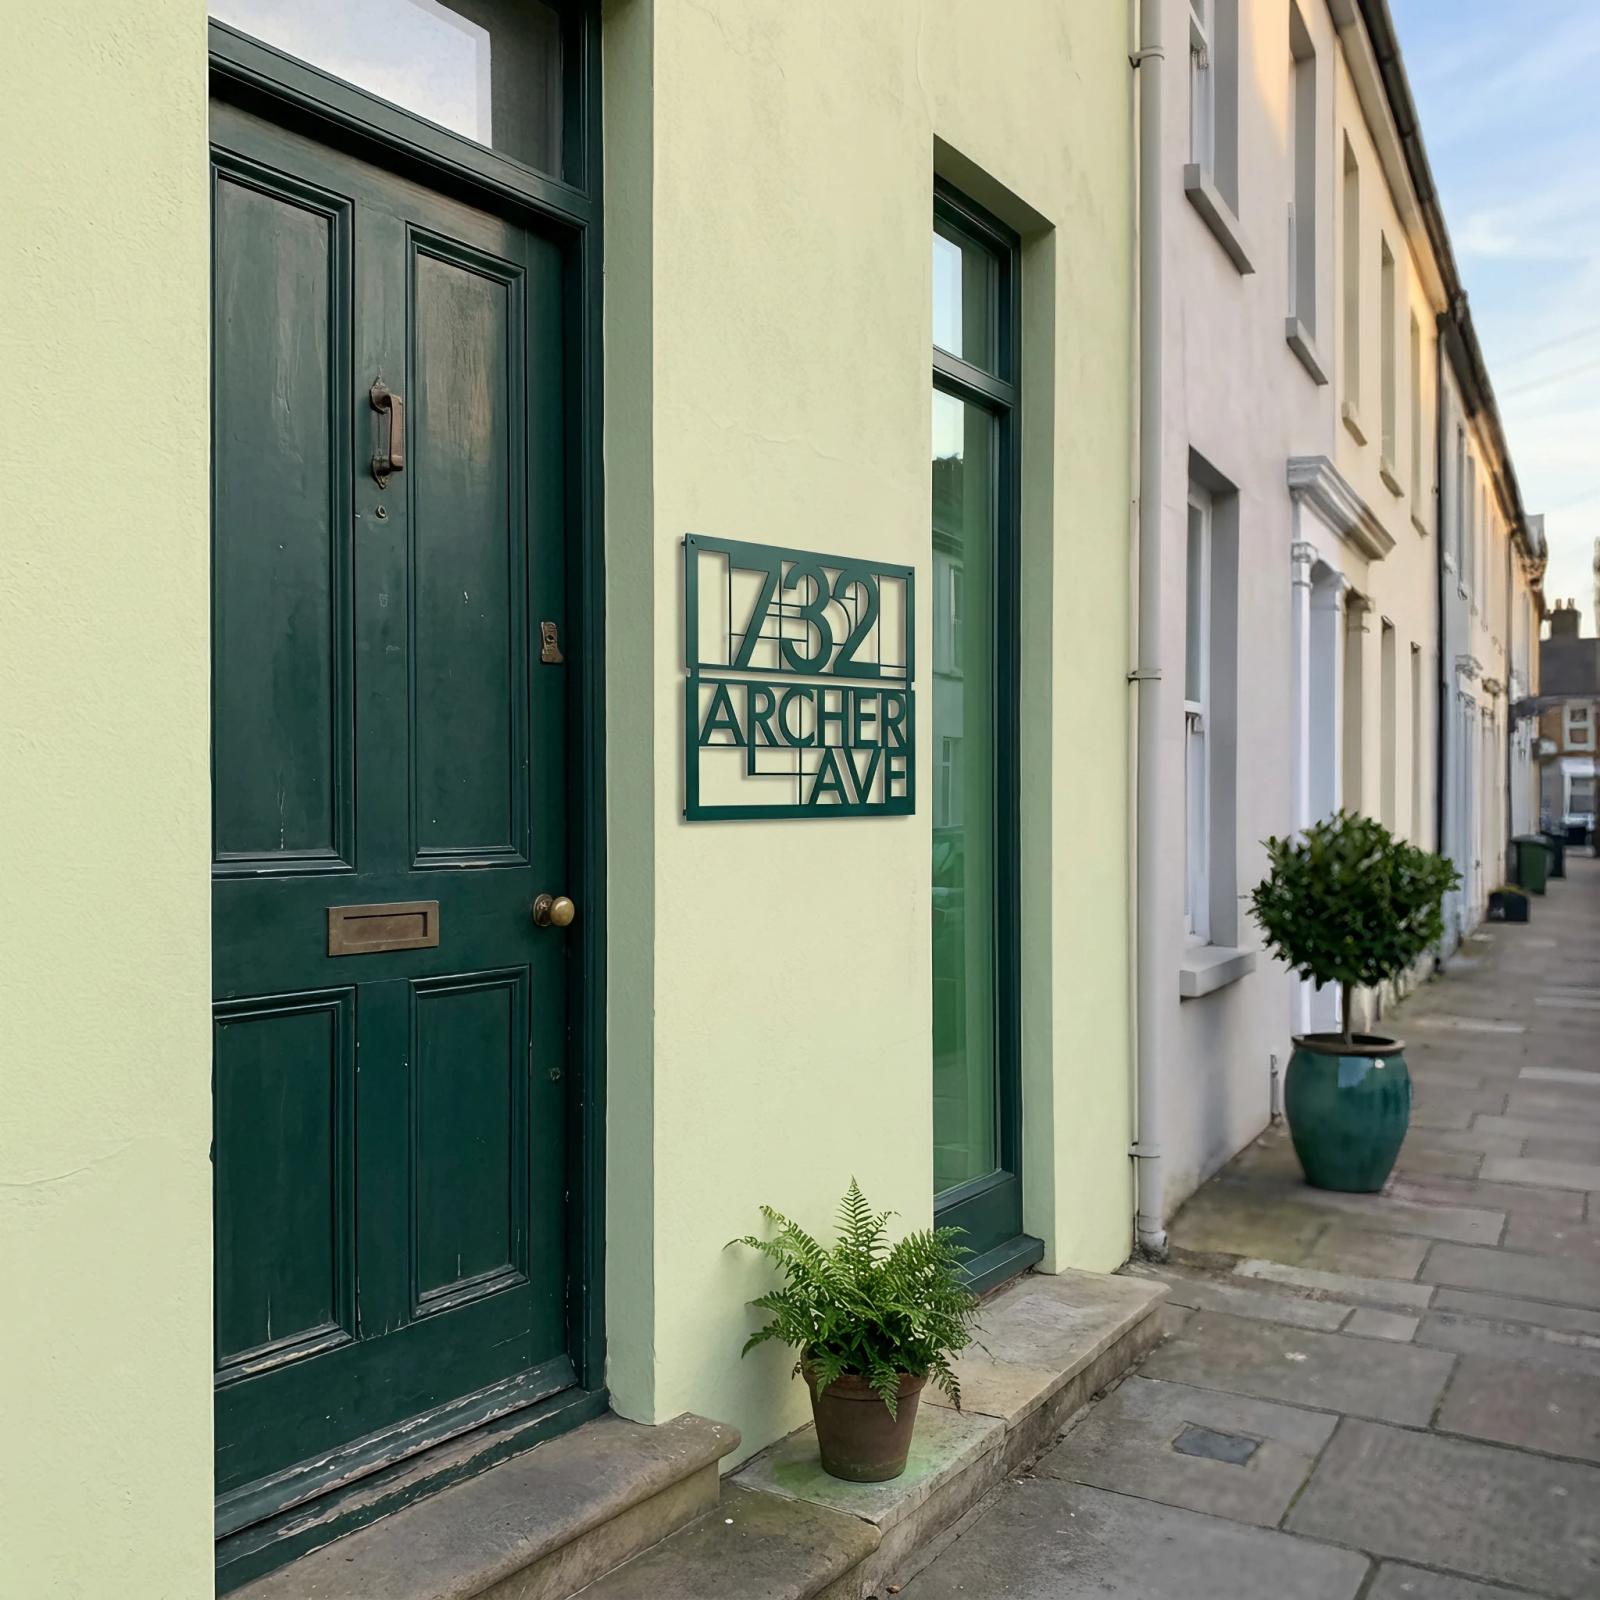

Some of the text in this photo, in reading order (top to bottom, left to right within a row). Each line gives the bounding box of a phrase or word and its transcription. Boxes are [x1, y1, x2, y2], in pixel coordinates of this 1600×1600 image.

[730, 555, 880, 674] 732
[699, 683, 907, 748] ARCHER
[807, 747, 907, 805] AVE
